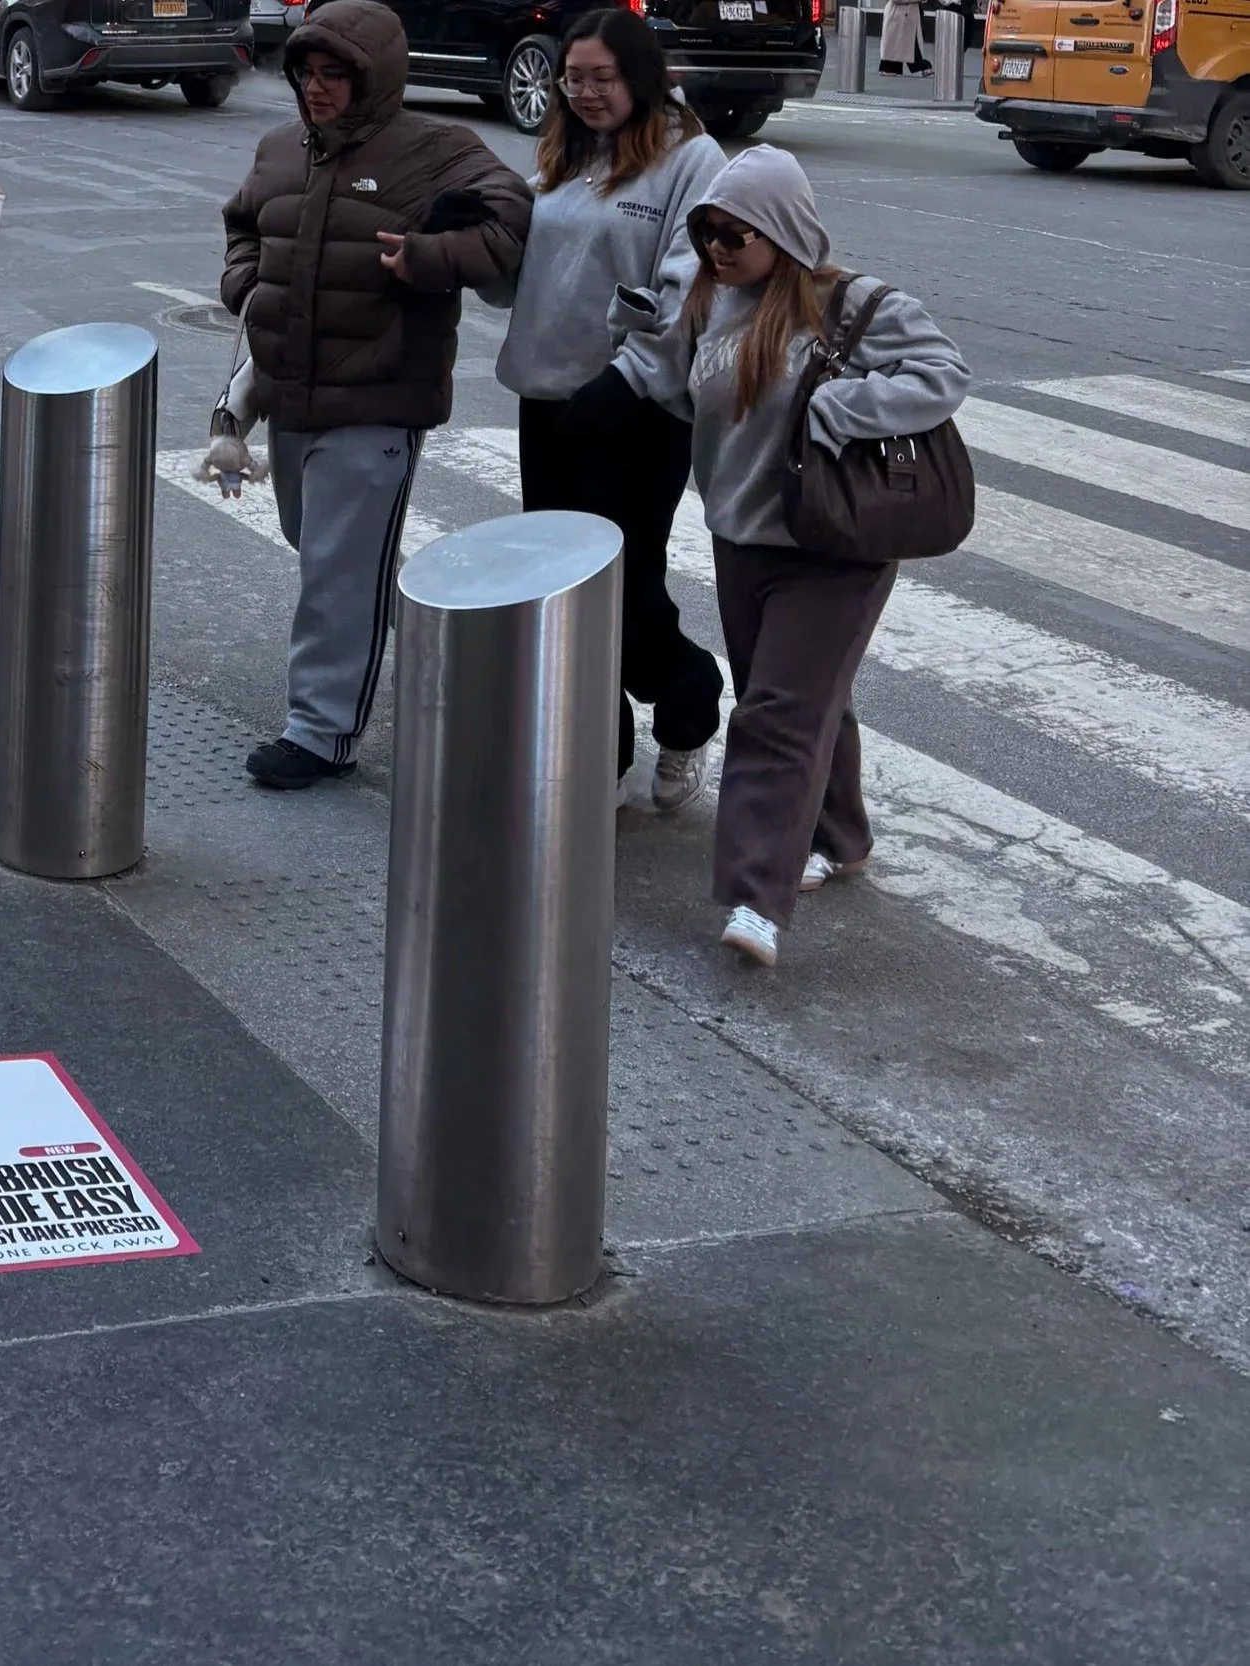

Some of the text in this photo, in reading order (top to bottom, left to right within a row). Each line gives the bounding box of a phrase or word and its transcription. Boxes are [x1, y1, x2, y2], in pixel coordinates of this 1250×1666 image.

[44, 1144, 76, 1156] NEW
[42, 1185, 142, 1220] EASY
[18, 1222, 75, 1242] BAKE
[71, 1215, 161, 1238] PRESSED
[40, 1242, 104, 1255] BLOCK
[113, 1235, 165, 1249] AWAY
